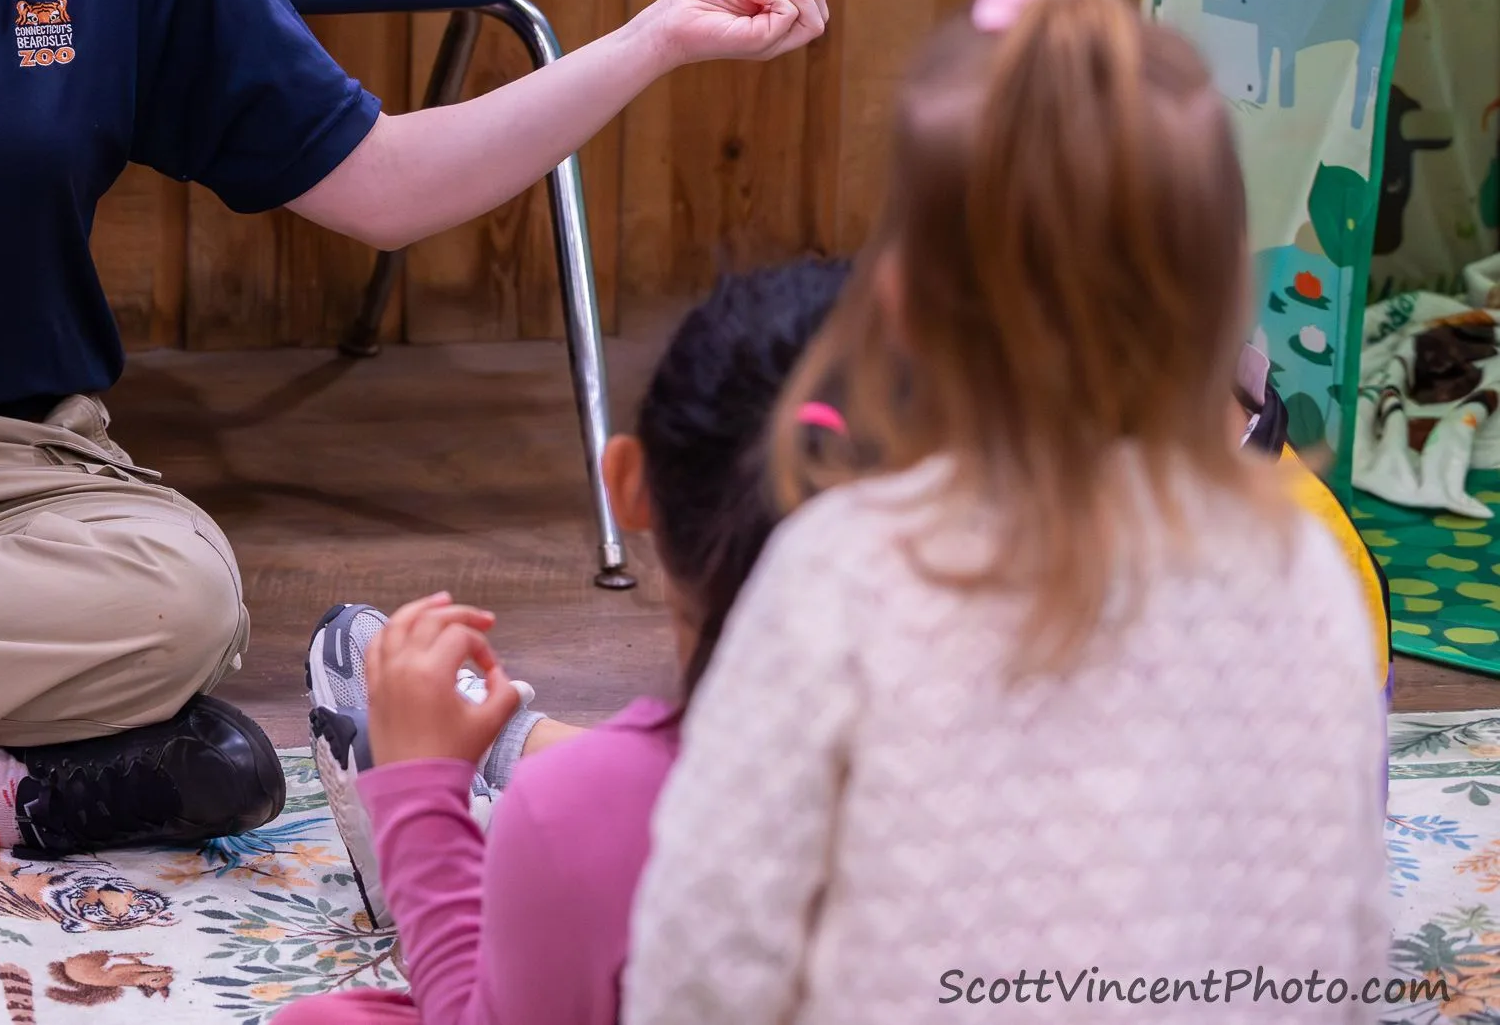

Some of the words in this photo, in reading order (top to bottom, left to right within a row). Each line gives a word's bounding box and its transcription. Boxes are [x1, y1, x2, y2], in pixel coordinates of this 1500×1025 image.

[15, 24, 73, 36] CONNECTICUT'S
[16, 33, 73, 49] BEARDSLEY
[18, 46, 75, 67] ZOO
